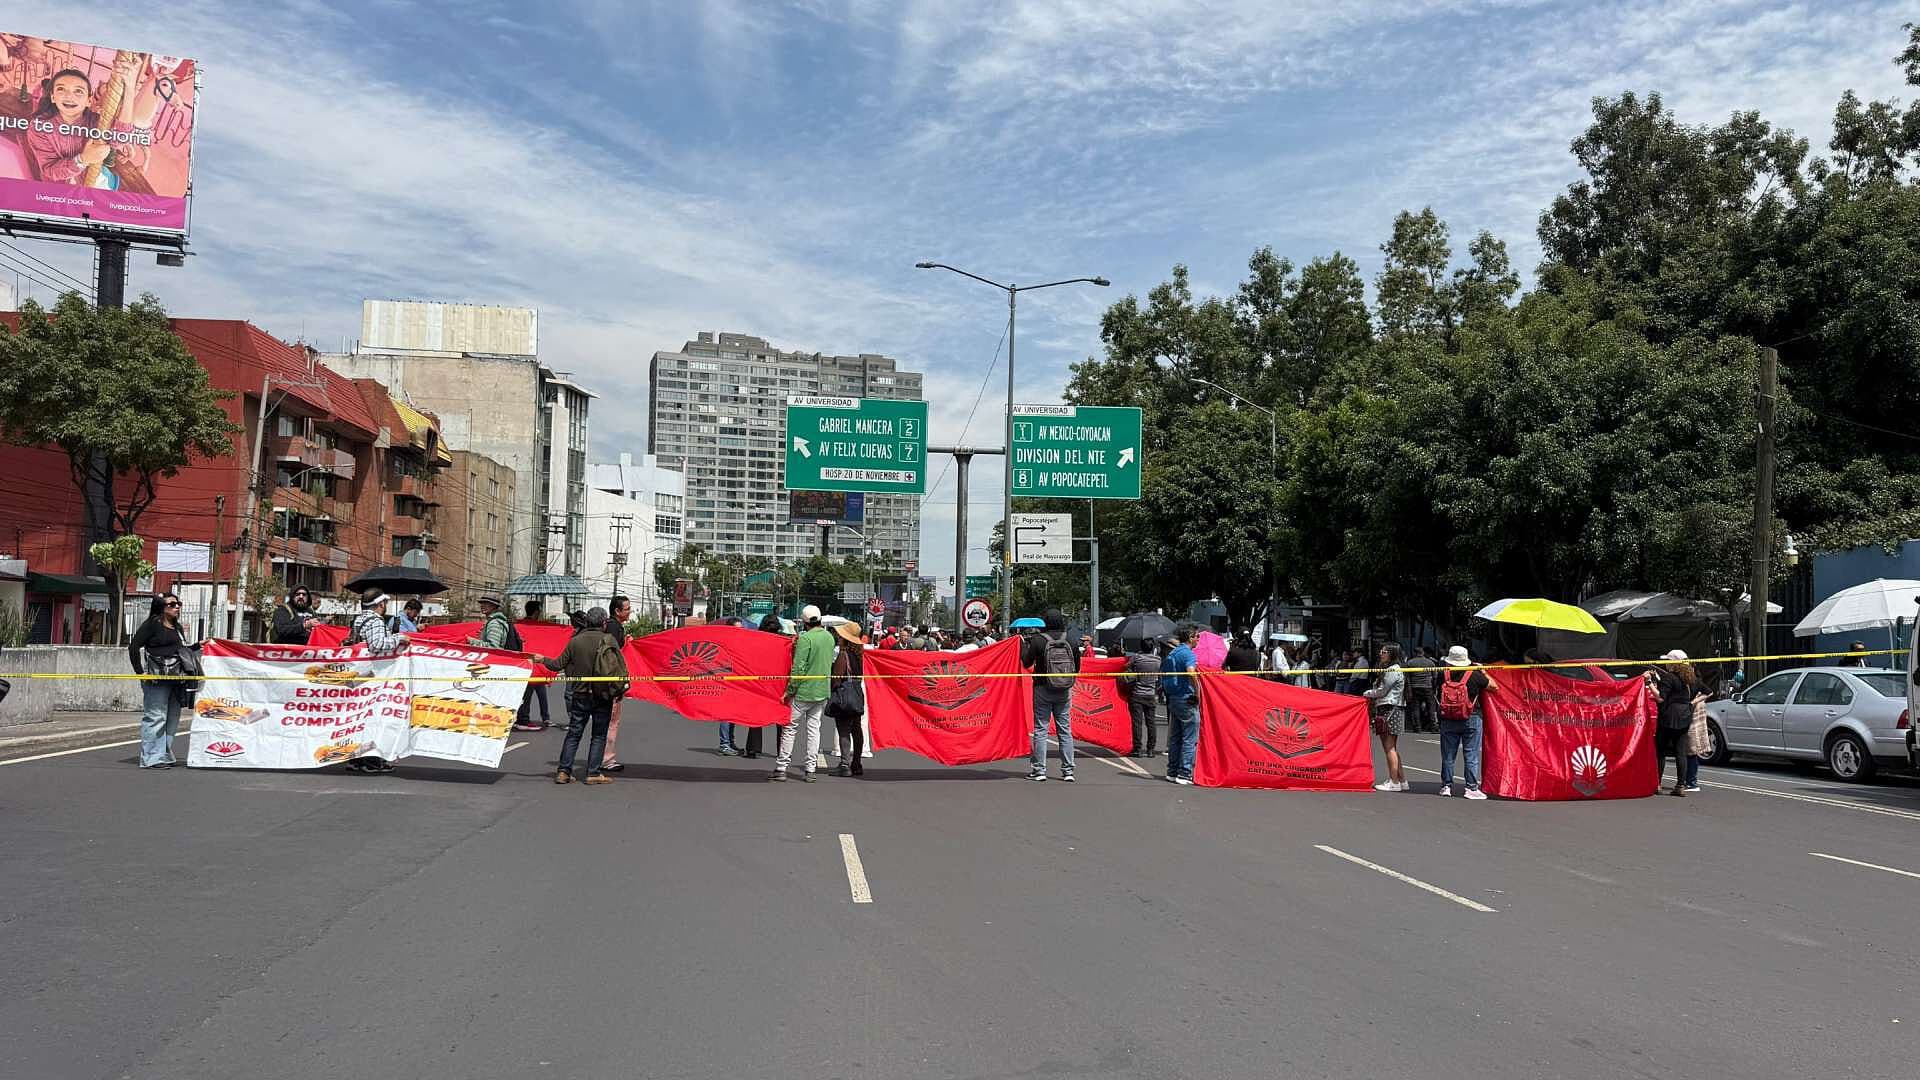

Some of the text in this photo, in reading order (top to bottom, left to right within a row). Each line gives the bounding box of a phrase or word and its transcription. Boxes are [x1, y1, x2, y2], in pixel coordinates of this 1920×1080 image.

[34, 118, 54, 133] te
[58, 124, 151, 146] emociona
[806, 397, 852, 407] UNIVERSIDAD
[1024, 406, 1068, 415] UNIVERSIDAD
[819, 417, 853, 434] GABRIEL
[855, 419, 893, 435] MANCERA
[1038, 425, 1048, 440] AV
[1049, 425, 1111, 442] MEXICO-COYOACAN
[819, 442, 831, 457] AV
[833, 442, 857, 458] FELIX
[860, 443, 893, 460] CUEVAS
[1016, 448, 1106, 465] DIVISION DEL NTE
[844, 470, 853, 479] 20
[855, 471, 863, 479] DE
[865, 471, 900, 481] NOVIEMBRE
[1038, 472, 1049, 487] AV
[1051, 472, 1109, 488] POPOCATEPETL
[295, 680, 406, 699] EXIGIMOS LA
[281, 709, 374, 727] COMPLETA
[330, 723, 366, 740] IEMS
